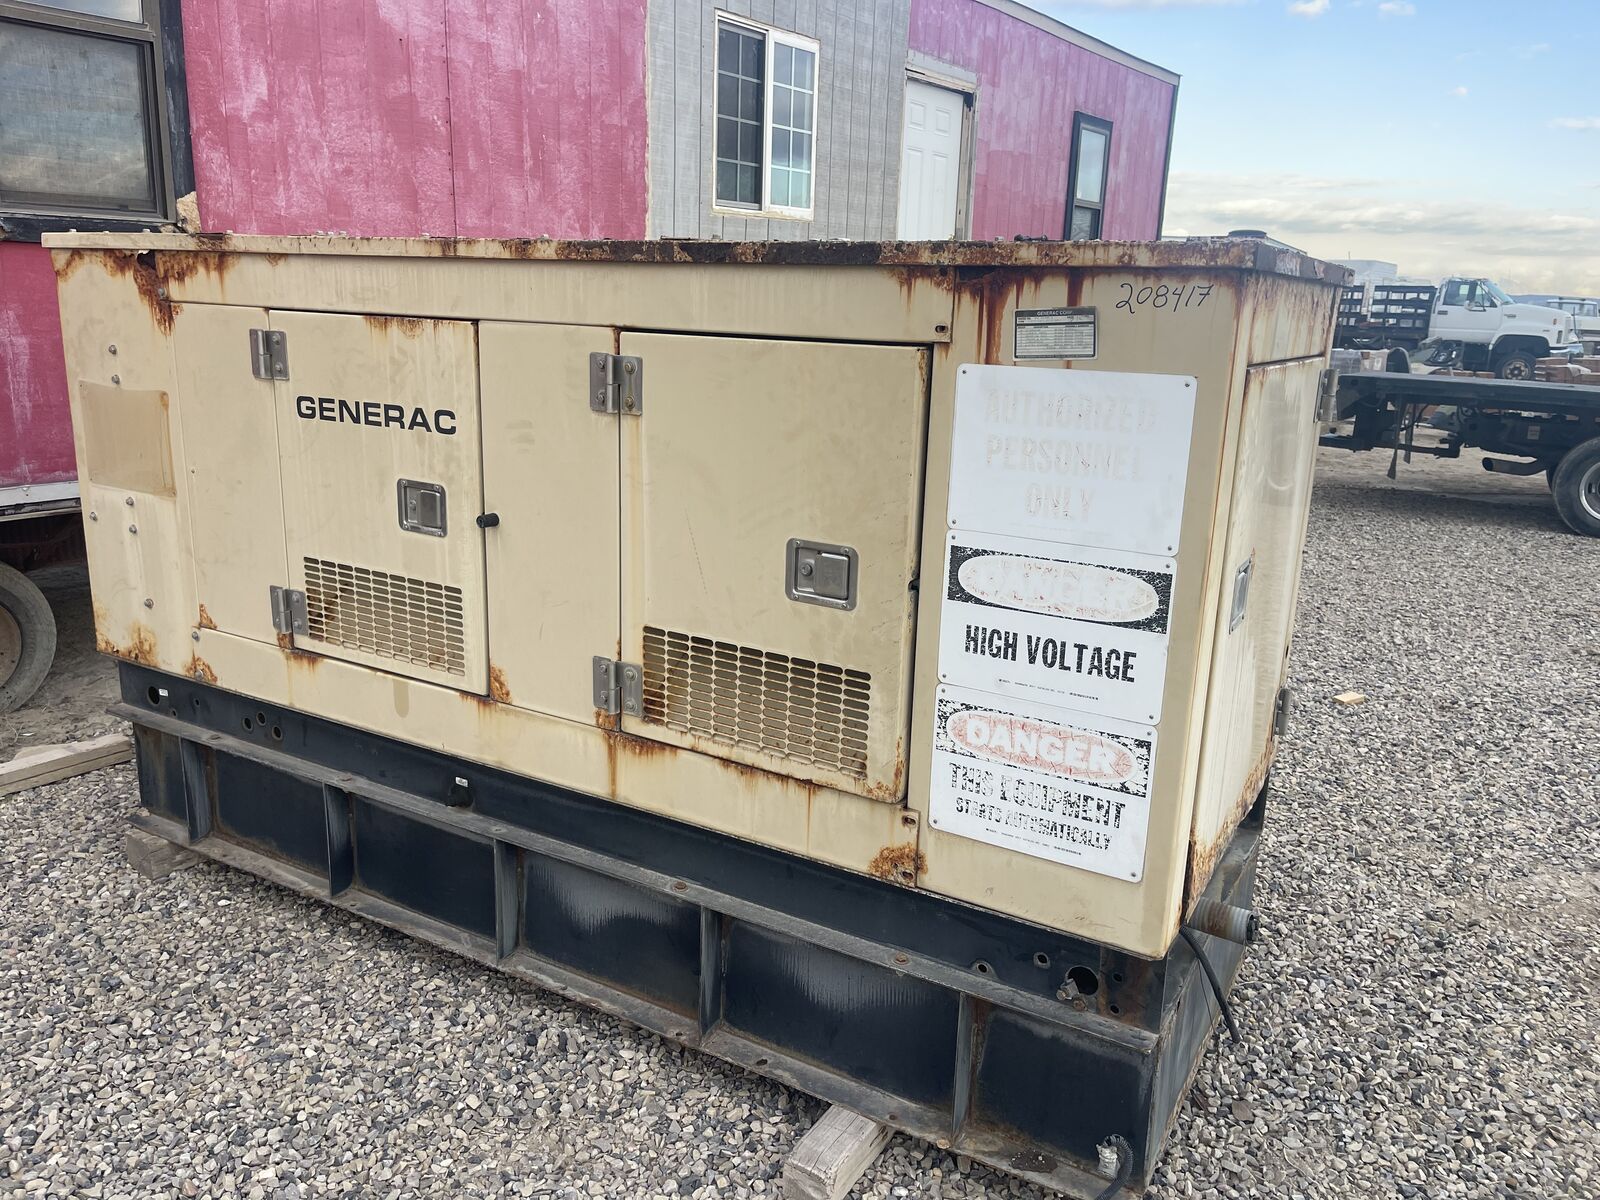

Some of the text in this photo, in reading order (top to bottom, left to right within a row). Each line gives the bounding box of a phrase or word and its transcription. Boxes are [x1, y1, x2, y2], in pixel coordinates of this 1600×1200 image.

[1115, 282, 1215, 314] 208417
[296, 395, 457, 435] GENERAC
[984, 387, 1158, 434] AUTHORIZED
[985, 434, 1145, 482] PERSONNEL
[1025, 482, 1096, 523] ONLY
[964, 624, 1137, 683] HIGH VOLTAGE
[966, 718, 1117, 775] DANGER
[948, 762, 1126, 829] THIS EQUIPMENT
[955, 797, 1002, 823] STARTS
[1004, 810, 1112, 851] AUTOMATICALLY
